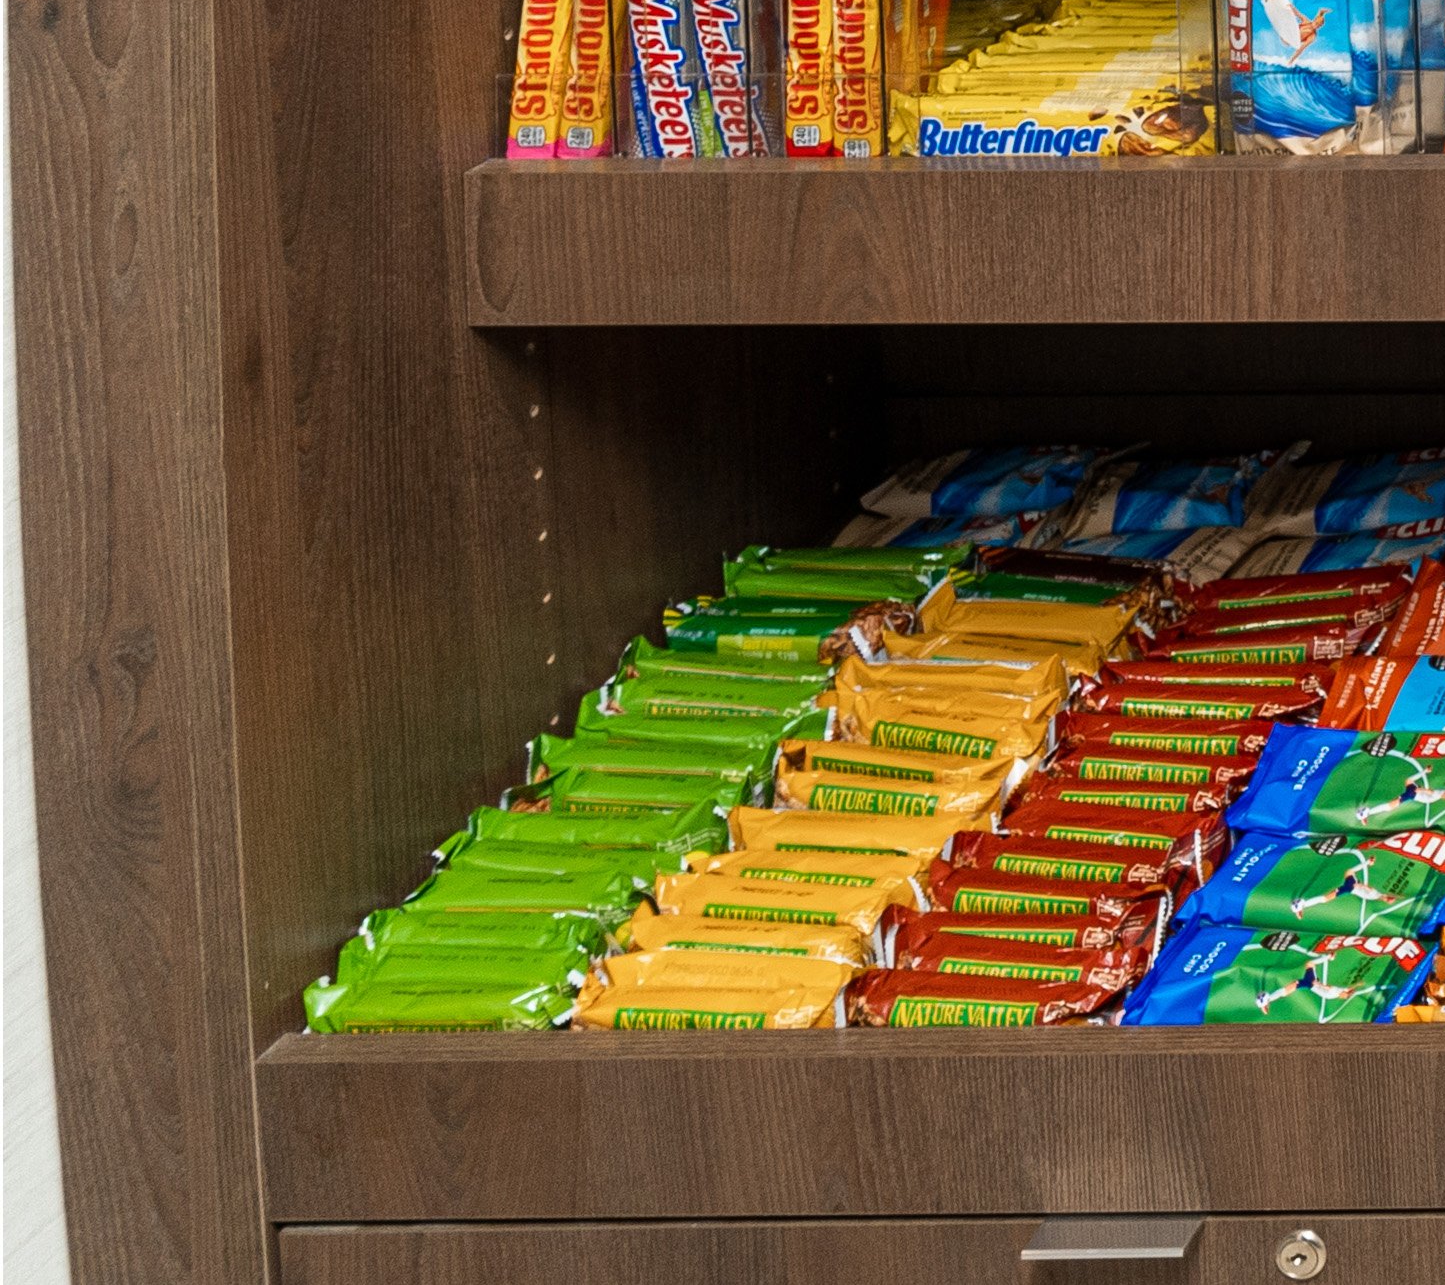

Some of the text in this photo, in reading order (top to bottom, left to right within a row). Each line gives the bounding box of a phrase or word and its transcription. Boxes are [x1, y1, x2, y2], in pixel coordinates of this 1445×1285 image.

[921, 117, 1108, 156] Butterfinger
[899, 1000, 1037, 1027] NATURE VALLEY
